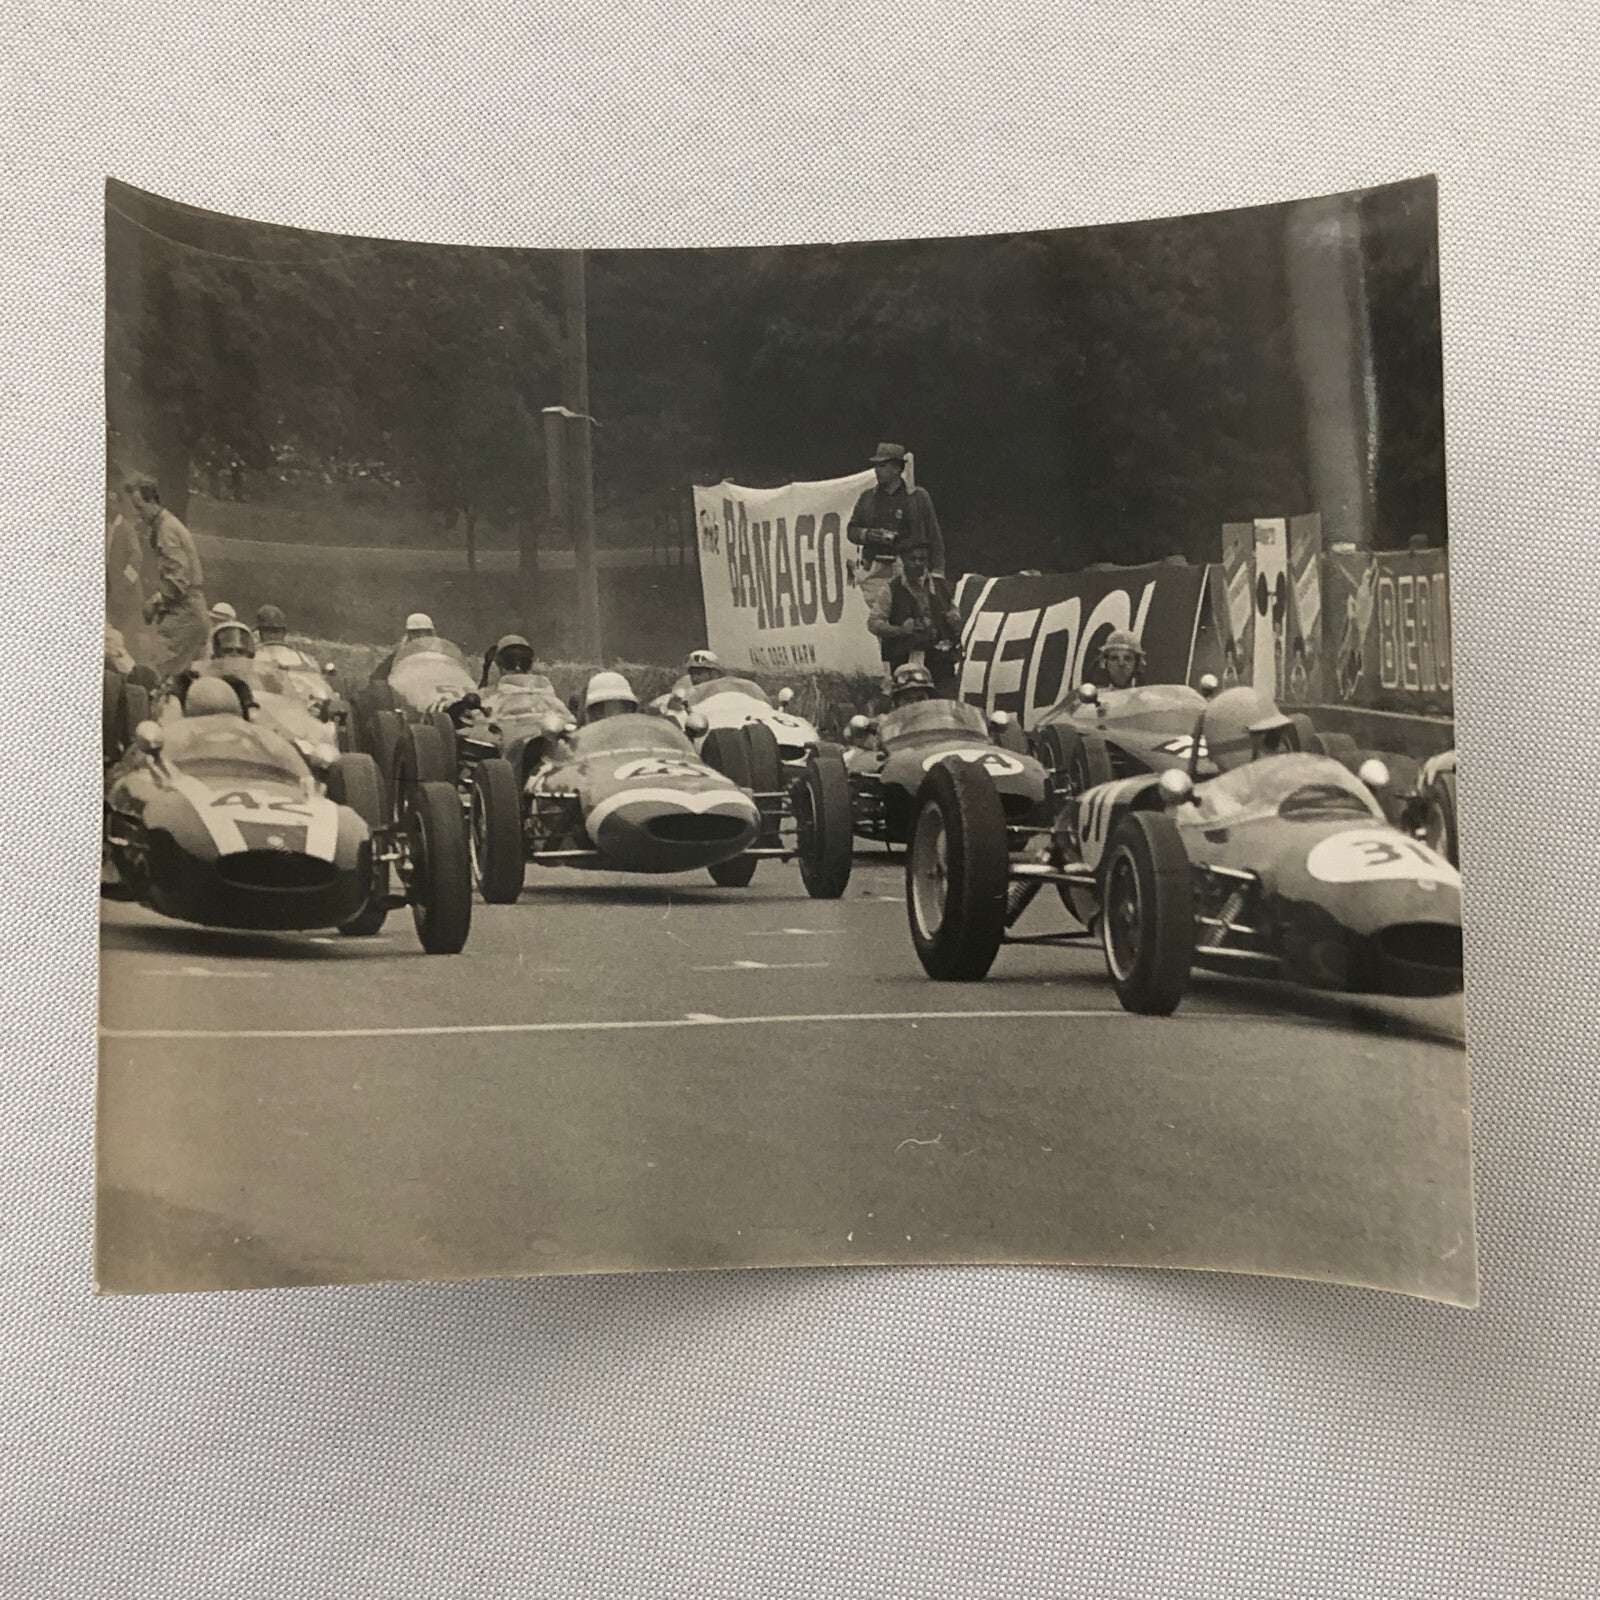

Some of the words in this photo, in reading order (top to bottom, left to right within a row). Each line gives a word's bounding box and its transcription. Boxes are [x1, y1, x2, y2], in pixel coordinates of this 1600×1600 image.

[722, 497, 844, 630] BANAGO
[209, 791, 314, 818] 42
[1352, 840, 1436, 867] 31
